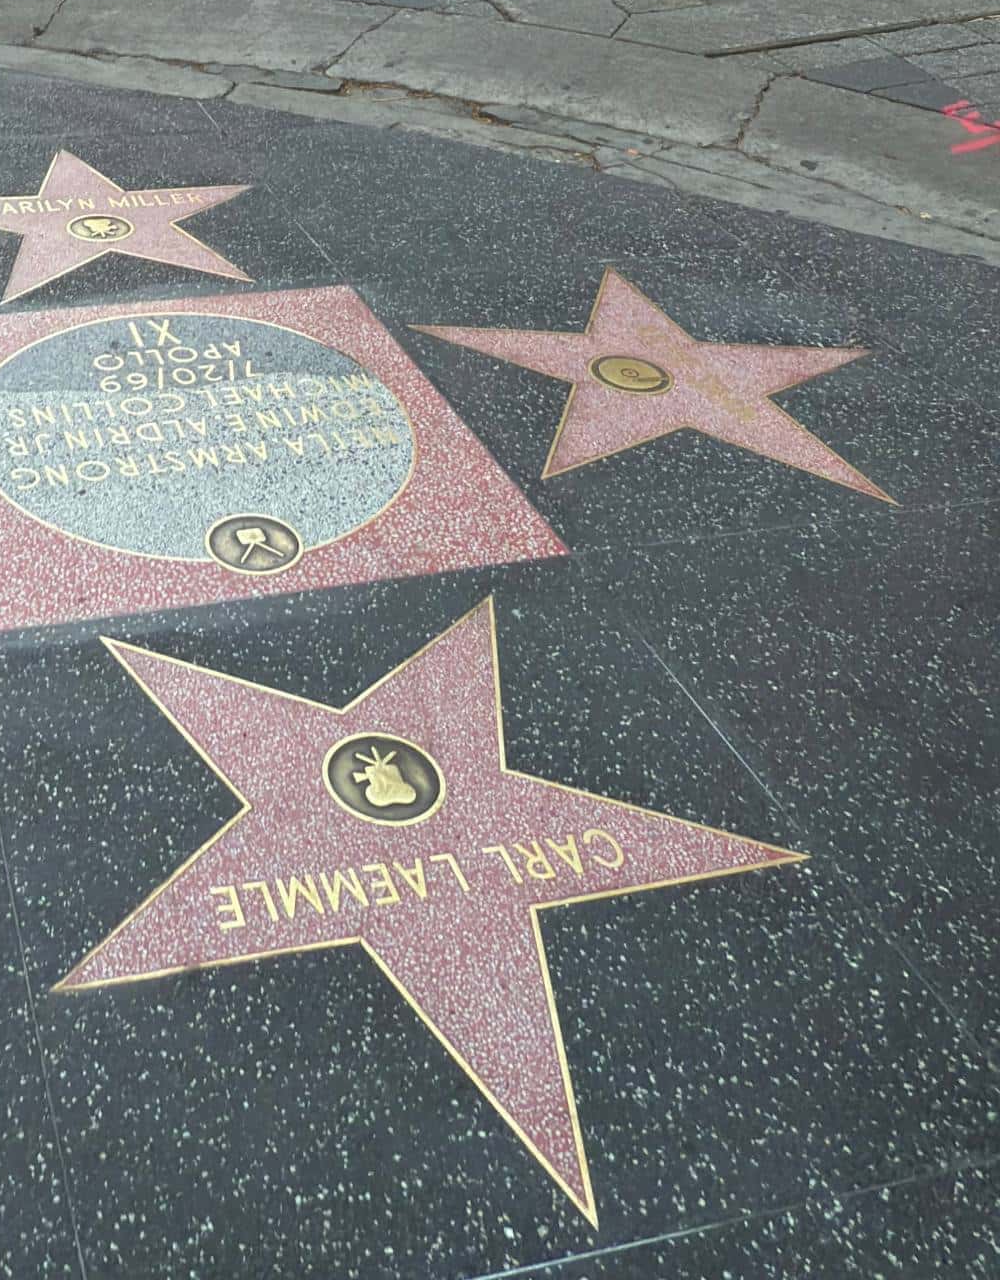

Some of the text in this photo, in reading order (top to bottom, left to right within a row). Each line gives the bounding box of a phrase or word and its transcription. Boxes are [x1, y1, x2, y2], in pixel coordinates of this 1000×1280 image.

[108, 192, 202, 210] MILLER
[129, 319, 182, 347] XI
[93, 340, 241, 371] APOLLO
[100, 360, 265, 393] 7/20/69
[8, 373, 372, 428] MICHAEL COLLINS
[255, 398, 382, 430] EDWIN
[64, 417, 206, 450] ALDRIN
[308, 426, 398, 456] NEIL
[10, 439, 268, 489] ARMSTRONG
[210, 827, 624, 931] CARL LAEMMLE
